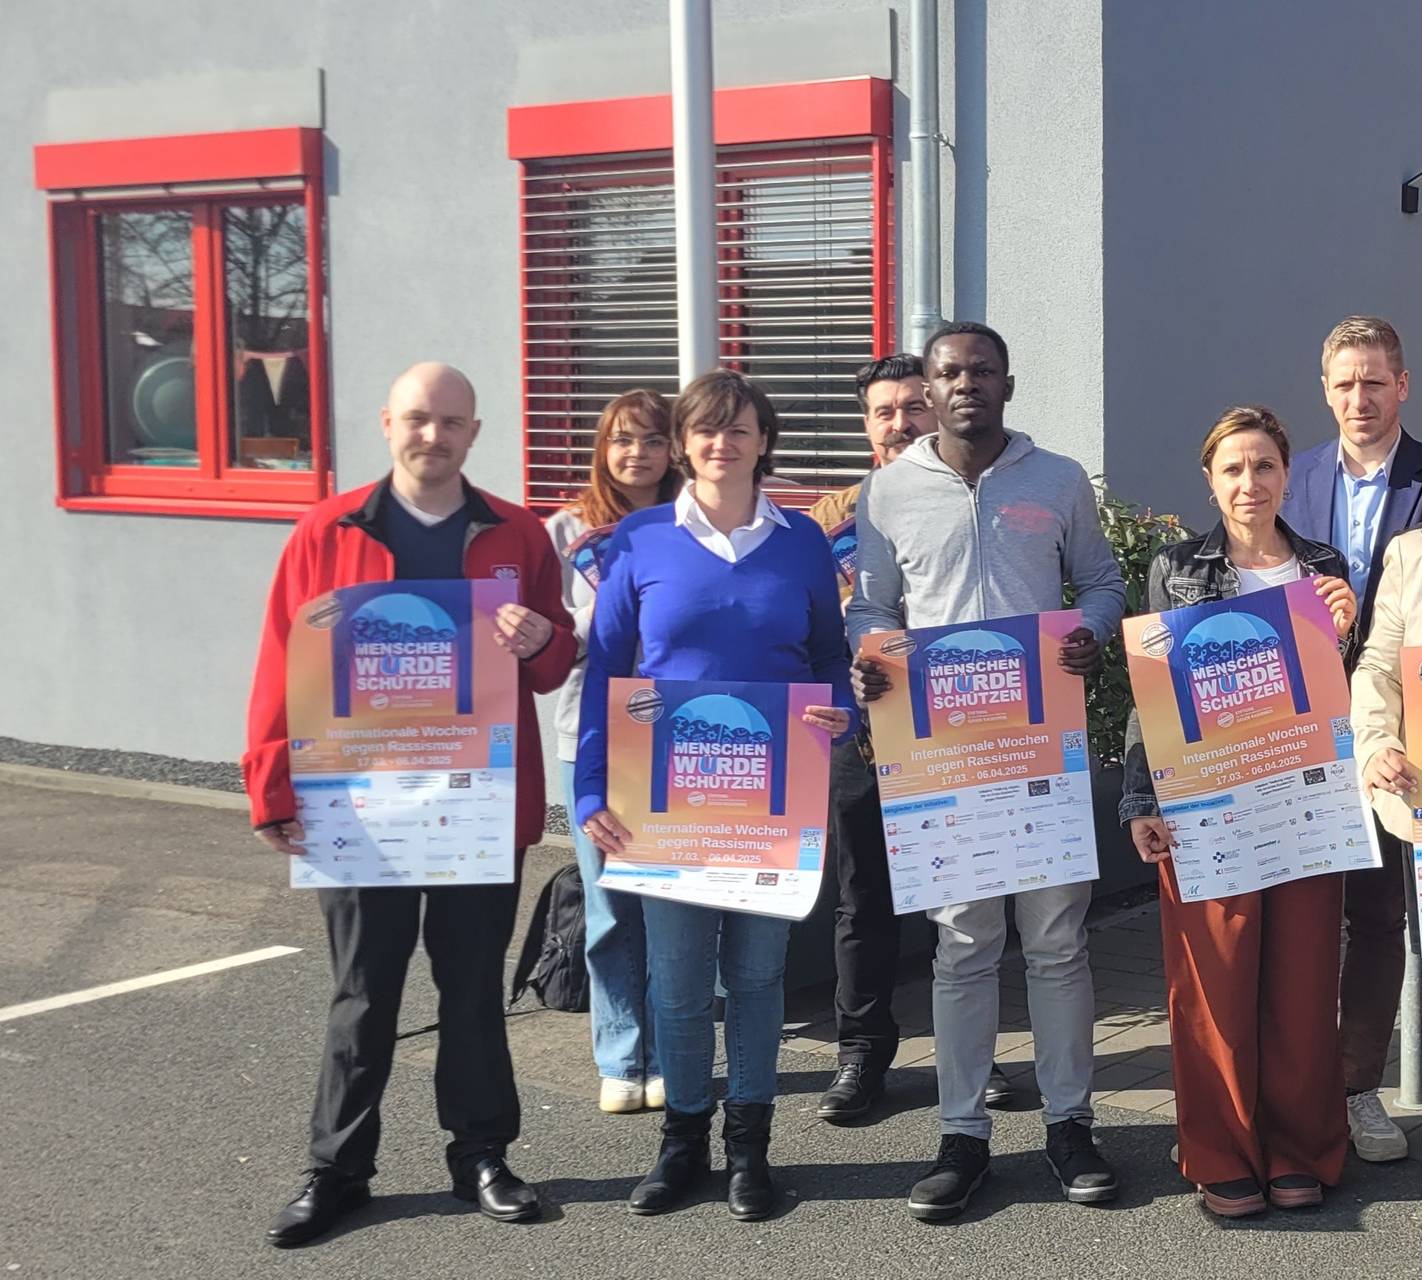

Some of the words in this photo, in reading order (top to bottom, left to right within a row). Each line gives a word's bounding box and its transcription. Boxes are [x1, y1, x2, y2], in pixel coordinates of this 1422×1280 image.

[355, 642, 451, 655] MENSCHEN
[355, 655, 451, 676] WÜRDE
[931, 658, 1020, 677] MENSCHEN
[1192, 648, 1278, 680] MENSCHEN
[356, 674, 451, 691] SCHÜTZEN
[931, 671, 1021, 695] WÜRDE
[1195, 661, 1283, 700] WÜRDE
[933, 689, 1022, 710] SCHÜTZEN
[1200, 680, 1285, 714] SCHÜTZEN
[422, 726, 478, 736] Wochen
[675, 742, 766, 755] MENSCHEN
[911, 741, 994, 761] Internationale
[997, 733, 1048, 748] Wochen
[1183, 735, 1265, 766] Internationale
[1267, 722, 1318, 742] Wochen
[674, 755, 766, 775] WÜRDE
[927, 759, 964, 775] gegen
[968, 751, 1036, 767] Rassismus
[1200, 759, 1238, 777] gegen
[1240, 740, 1308, 764] Rassismus
[1216, 771, 1244, 785] 17.03.
[1251, 755, 1301, 775] 06.04.2025
[674, 774, 765, 789] SCHÜTZEN
[642, 823, 731, 835] Internationale
[736, 825, 788, 837] Wochen
[657, 838, 698, 849] gegen
[702, 838, 772, 851] Rassismus
[671, 852, 700, 861] 17.03.
[709, 854, 762, 864] 06.04.2025
